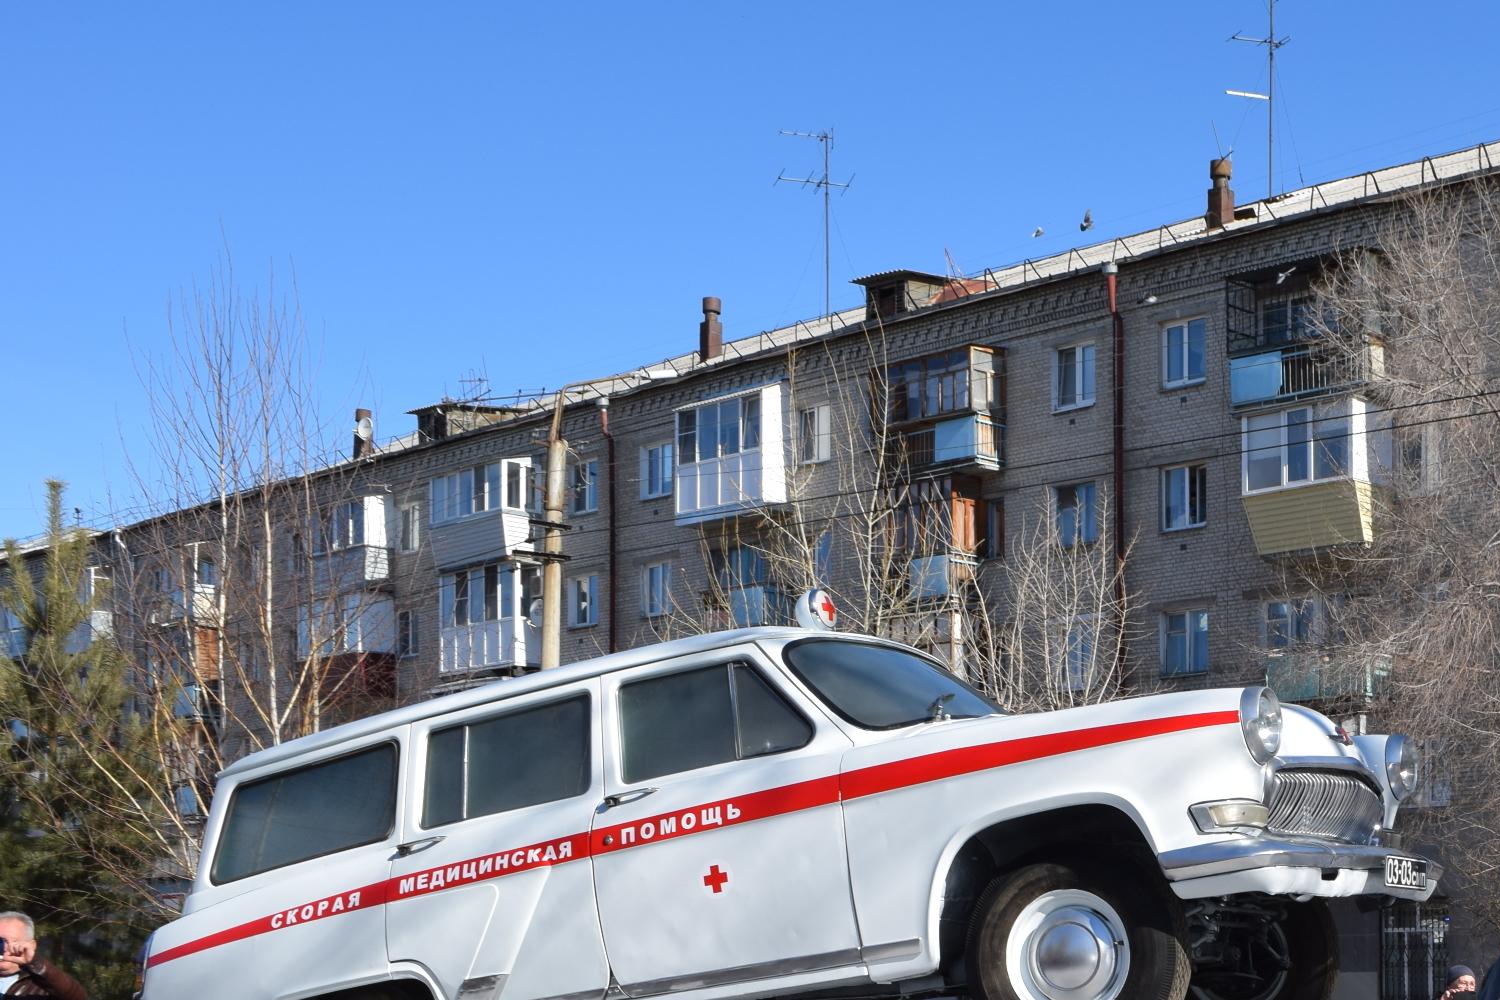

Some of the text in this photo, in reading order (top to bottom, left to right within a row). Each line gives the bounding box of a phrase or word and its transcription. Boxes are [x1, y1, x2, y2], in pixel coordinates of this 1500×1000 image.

[270, 803, 741, 929] СКОРАЯ МЕДИЦИНСКАЯ ПОМОЩЬ
